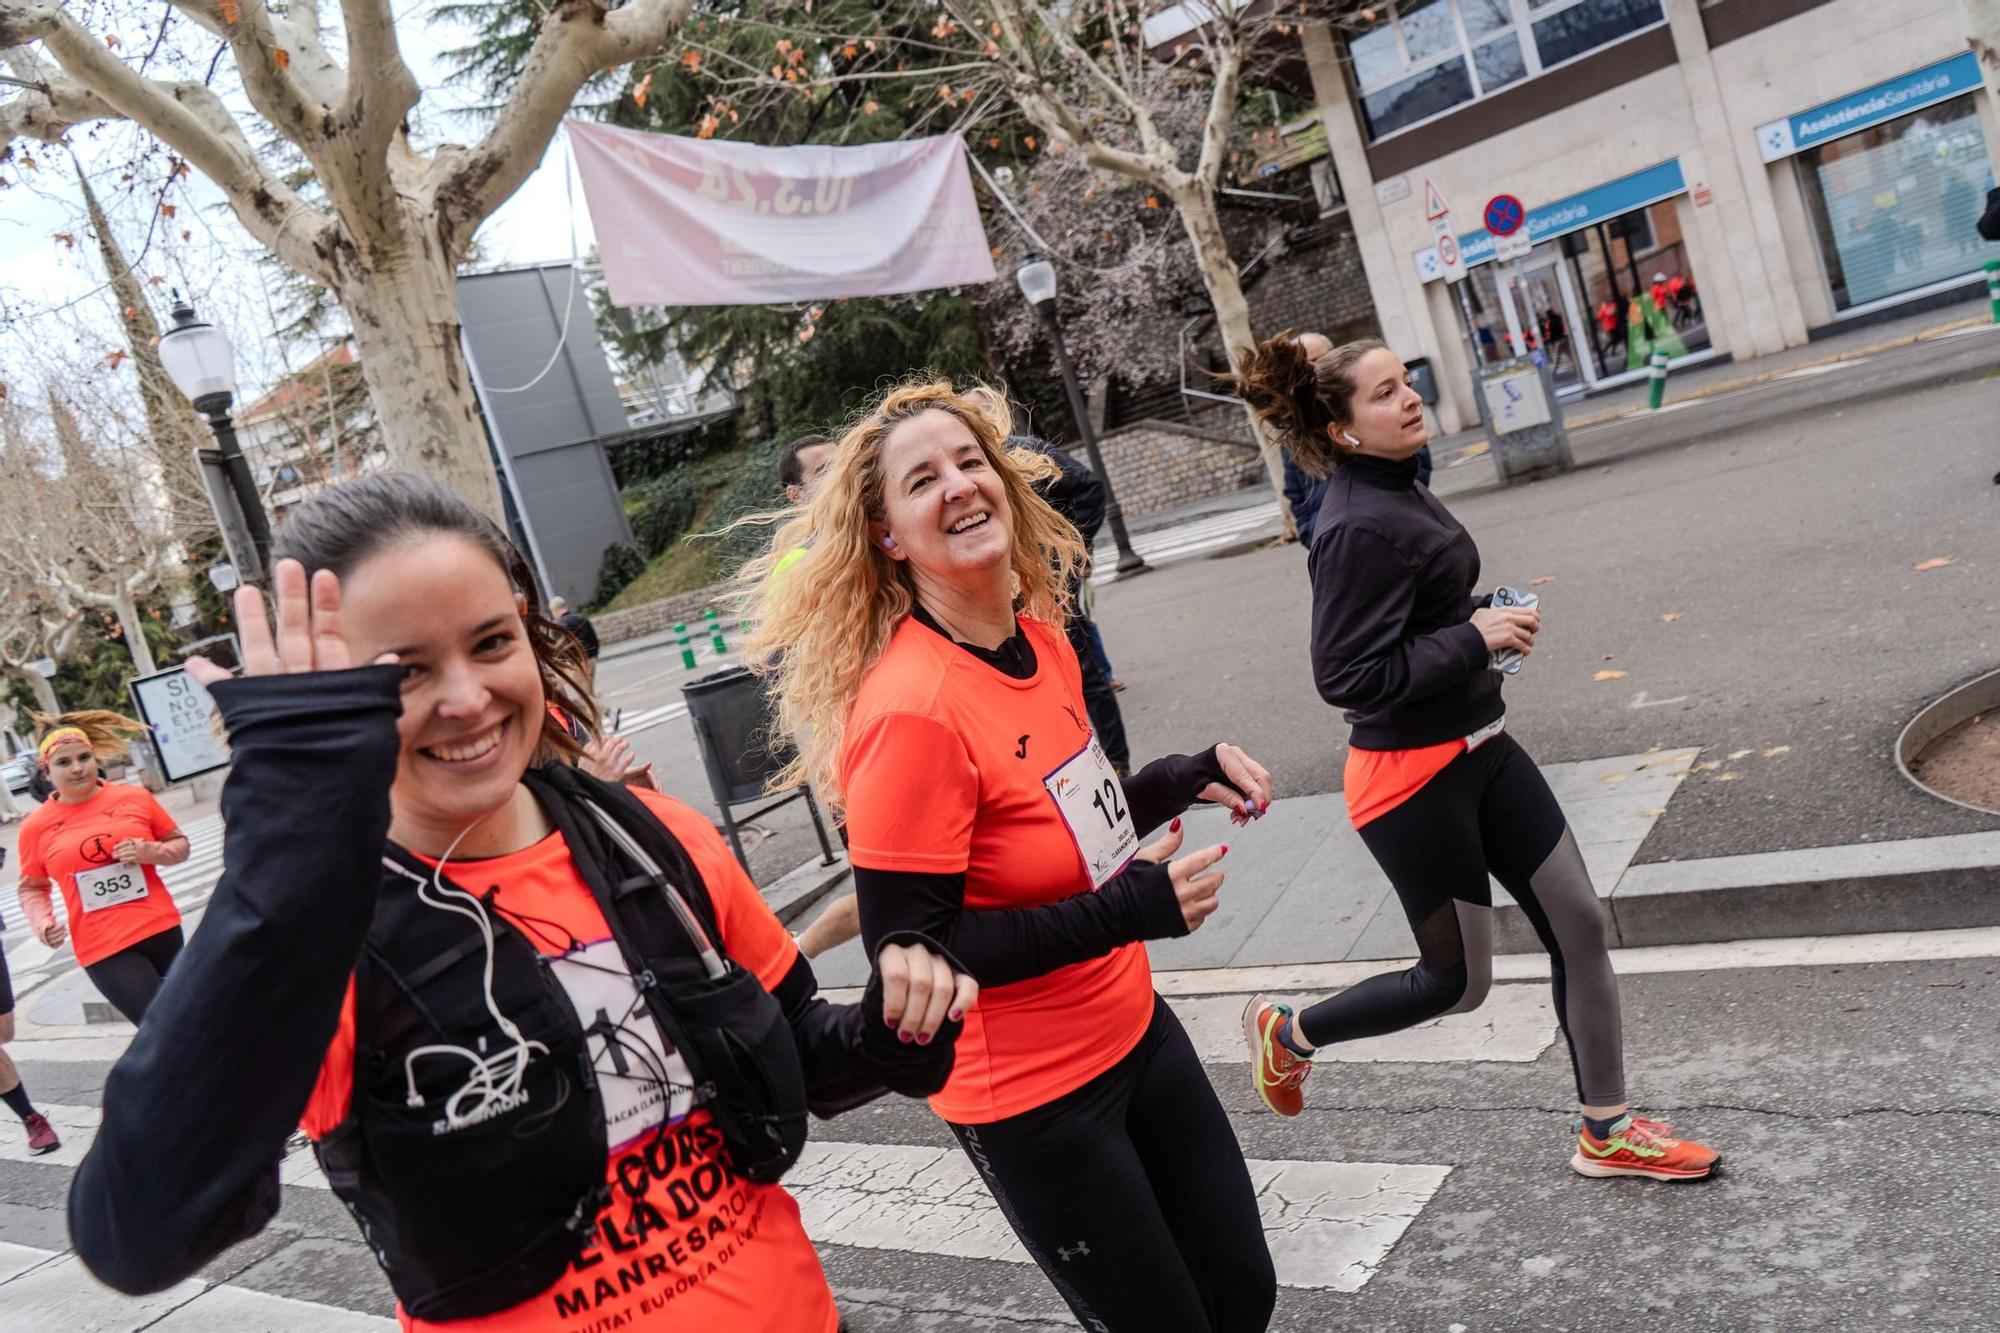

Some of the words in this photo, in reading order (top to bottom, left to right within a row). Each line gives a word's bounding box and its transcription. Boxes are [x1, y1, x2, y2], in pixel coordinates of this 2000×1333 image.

[166, 676, 190, 697] SI
[1092, 778, 1127, 830] 12
[94, 874, 132, 896] 353
